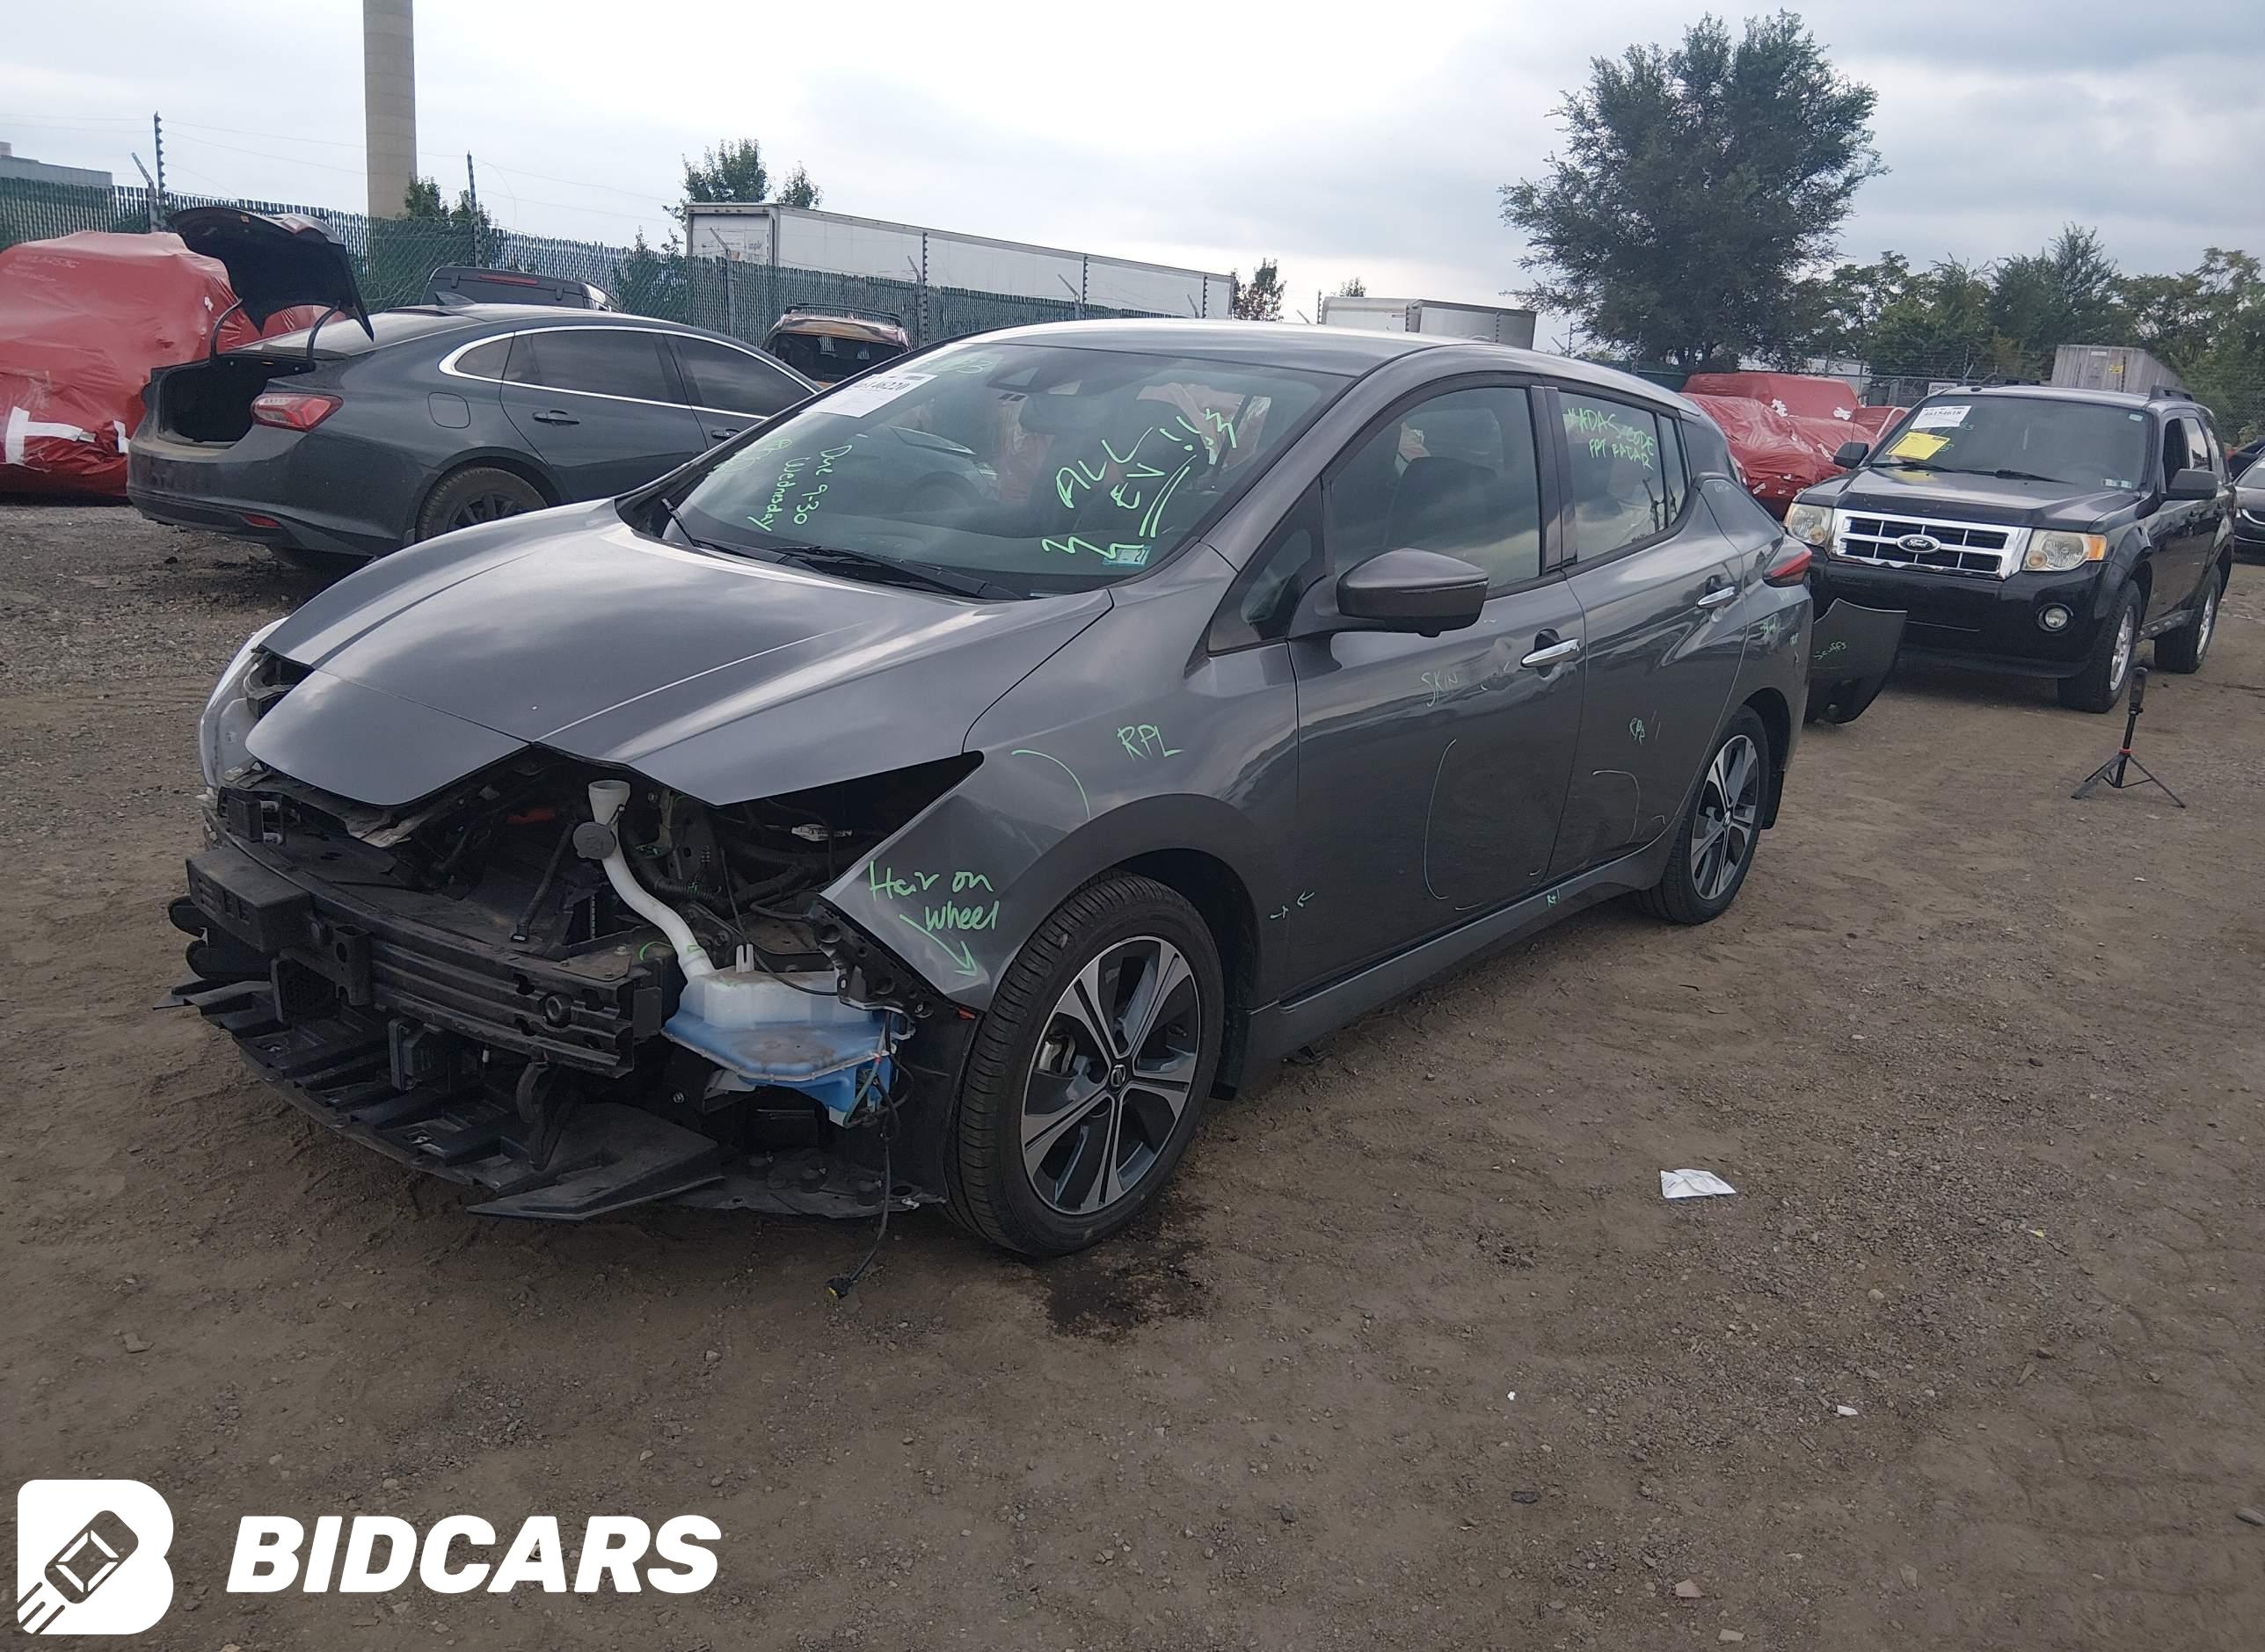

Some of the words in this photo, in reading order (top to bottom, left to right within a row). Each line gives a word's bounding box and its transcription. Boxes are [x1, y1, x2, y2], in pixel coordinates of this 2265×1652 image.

[747, 457, 812, 532] Wednesday
[1421, 670, 1458, 707] SKIN
[1116, 724, 1186, 761] RPL
[952, 870, 994, 894] on
[924, 900, 1000, 931] wheel
